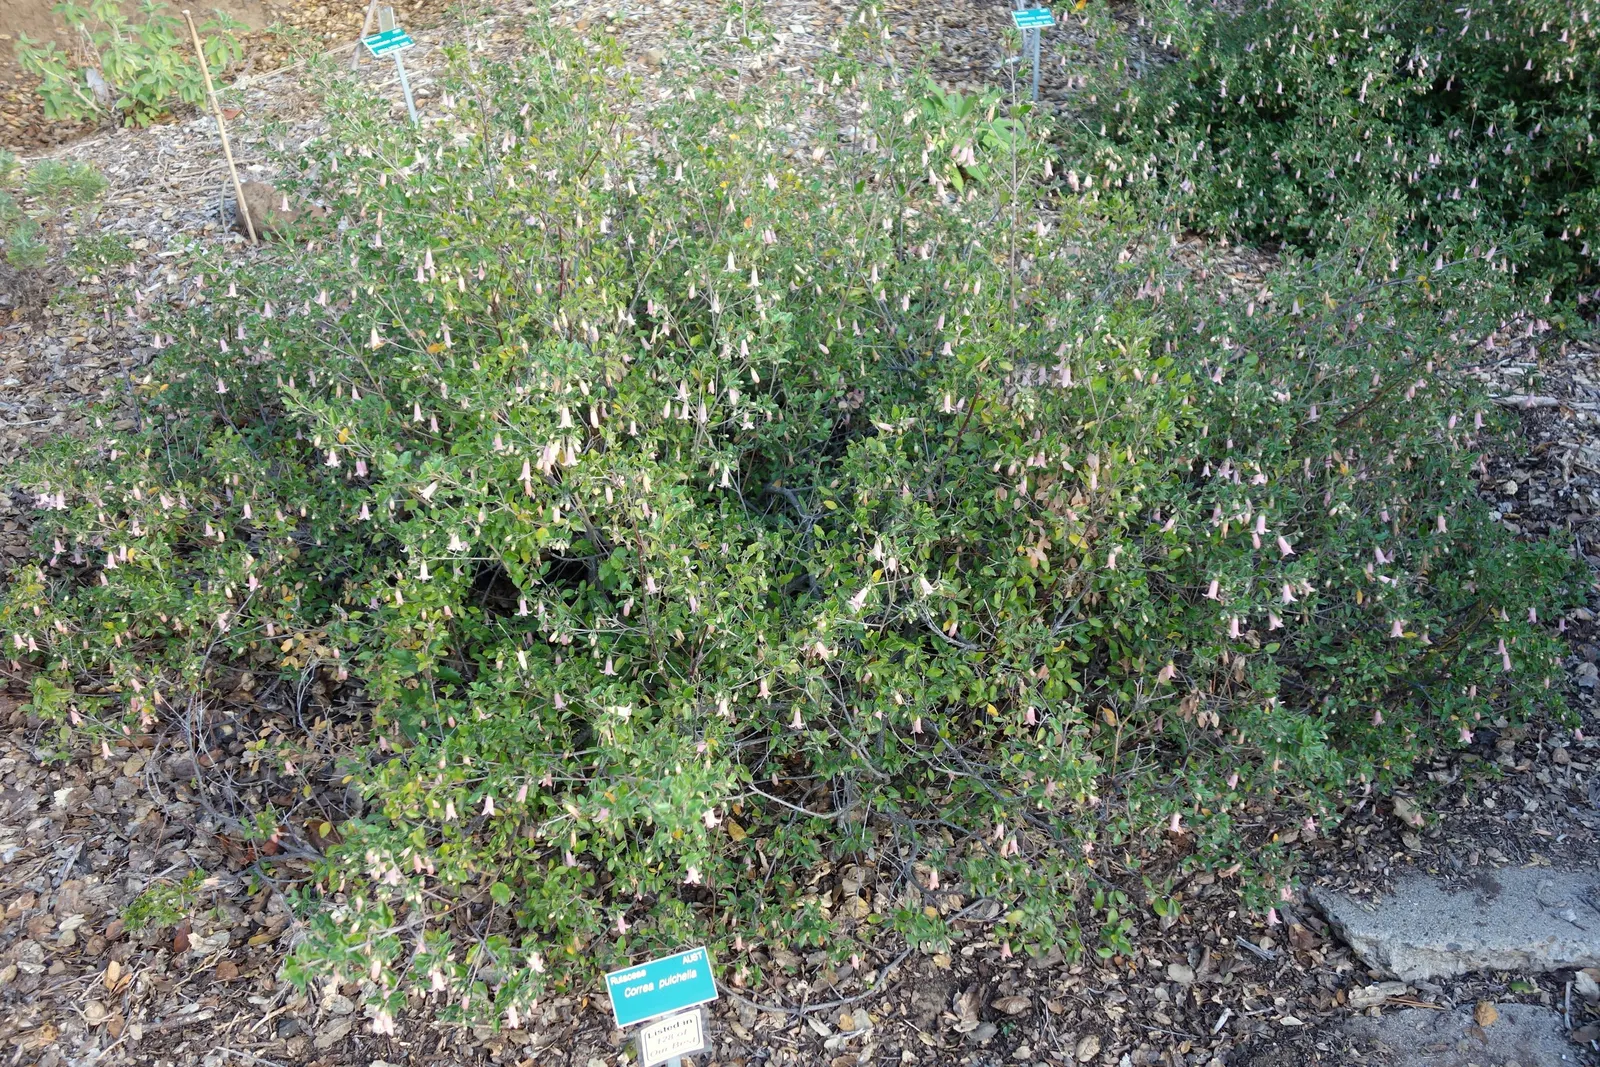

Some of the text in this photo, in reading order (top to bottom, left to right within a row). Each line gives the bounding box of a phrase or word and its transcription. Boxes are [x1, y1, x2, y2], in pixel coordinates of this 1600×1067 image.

[682, 951, 703, 965] AUST
[610, 969, 647, 986] Rutaceae
[624, 969, 697, 998] Correa pulchella
[648, 1018, 693, 1039] Listed in
